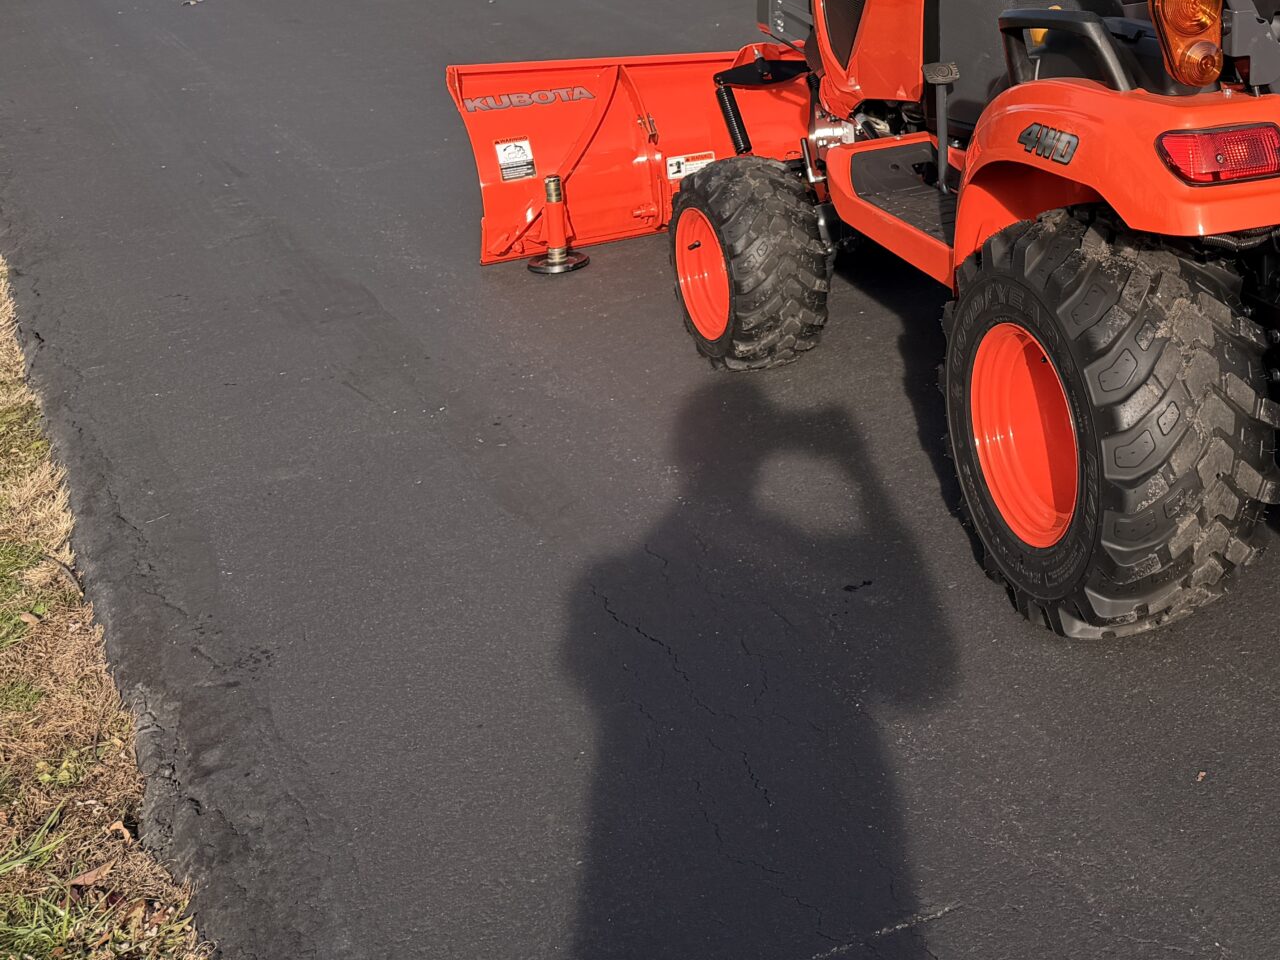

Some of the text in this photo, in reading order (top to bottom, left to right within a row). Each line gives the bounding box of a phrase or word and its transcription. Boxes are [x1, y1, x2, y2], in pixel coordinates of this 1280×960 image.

[463, 85, 596, 113] KUBOTA
[1017, 121, 1080, 166] 4WD
[952, 282, 1059, 375] GOODYEAR
